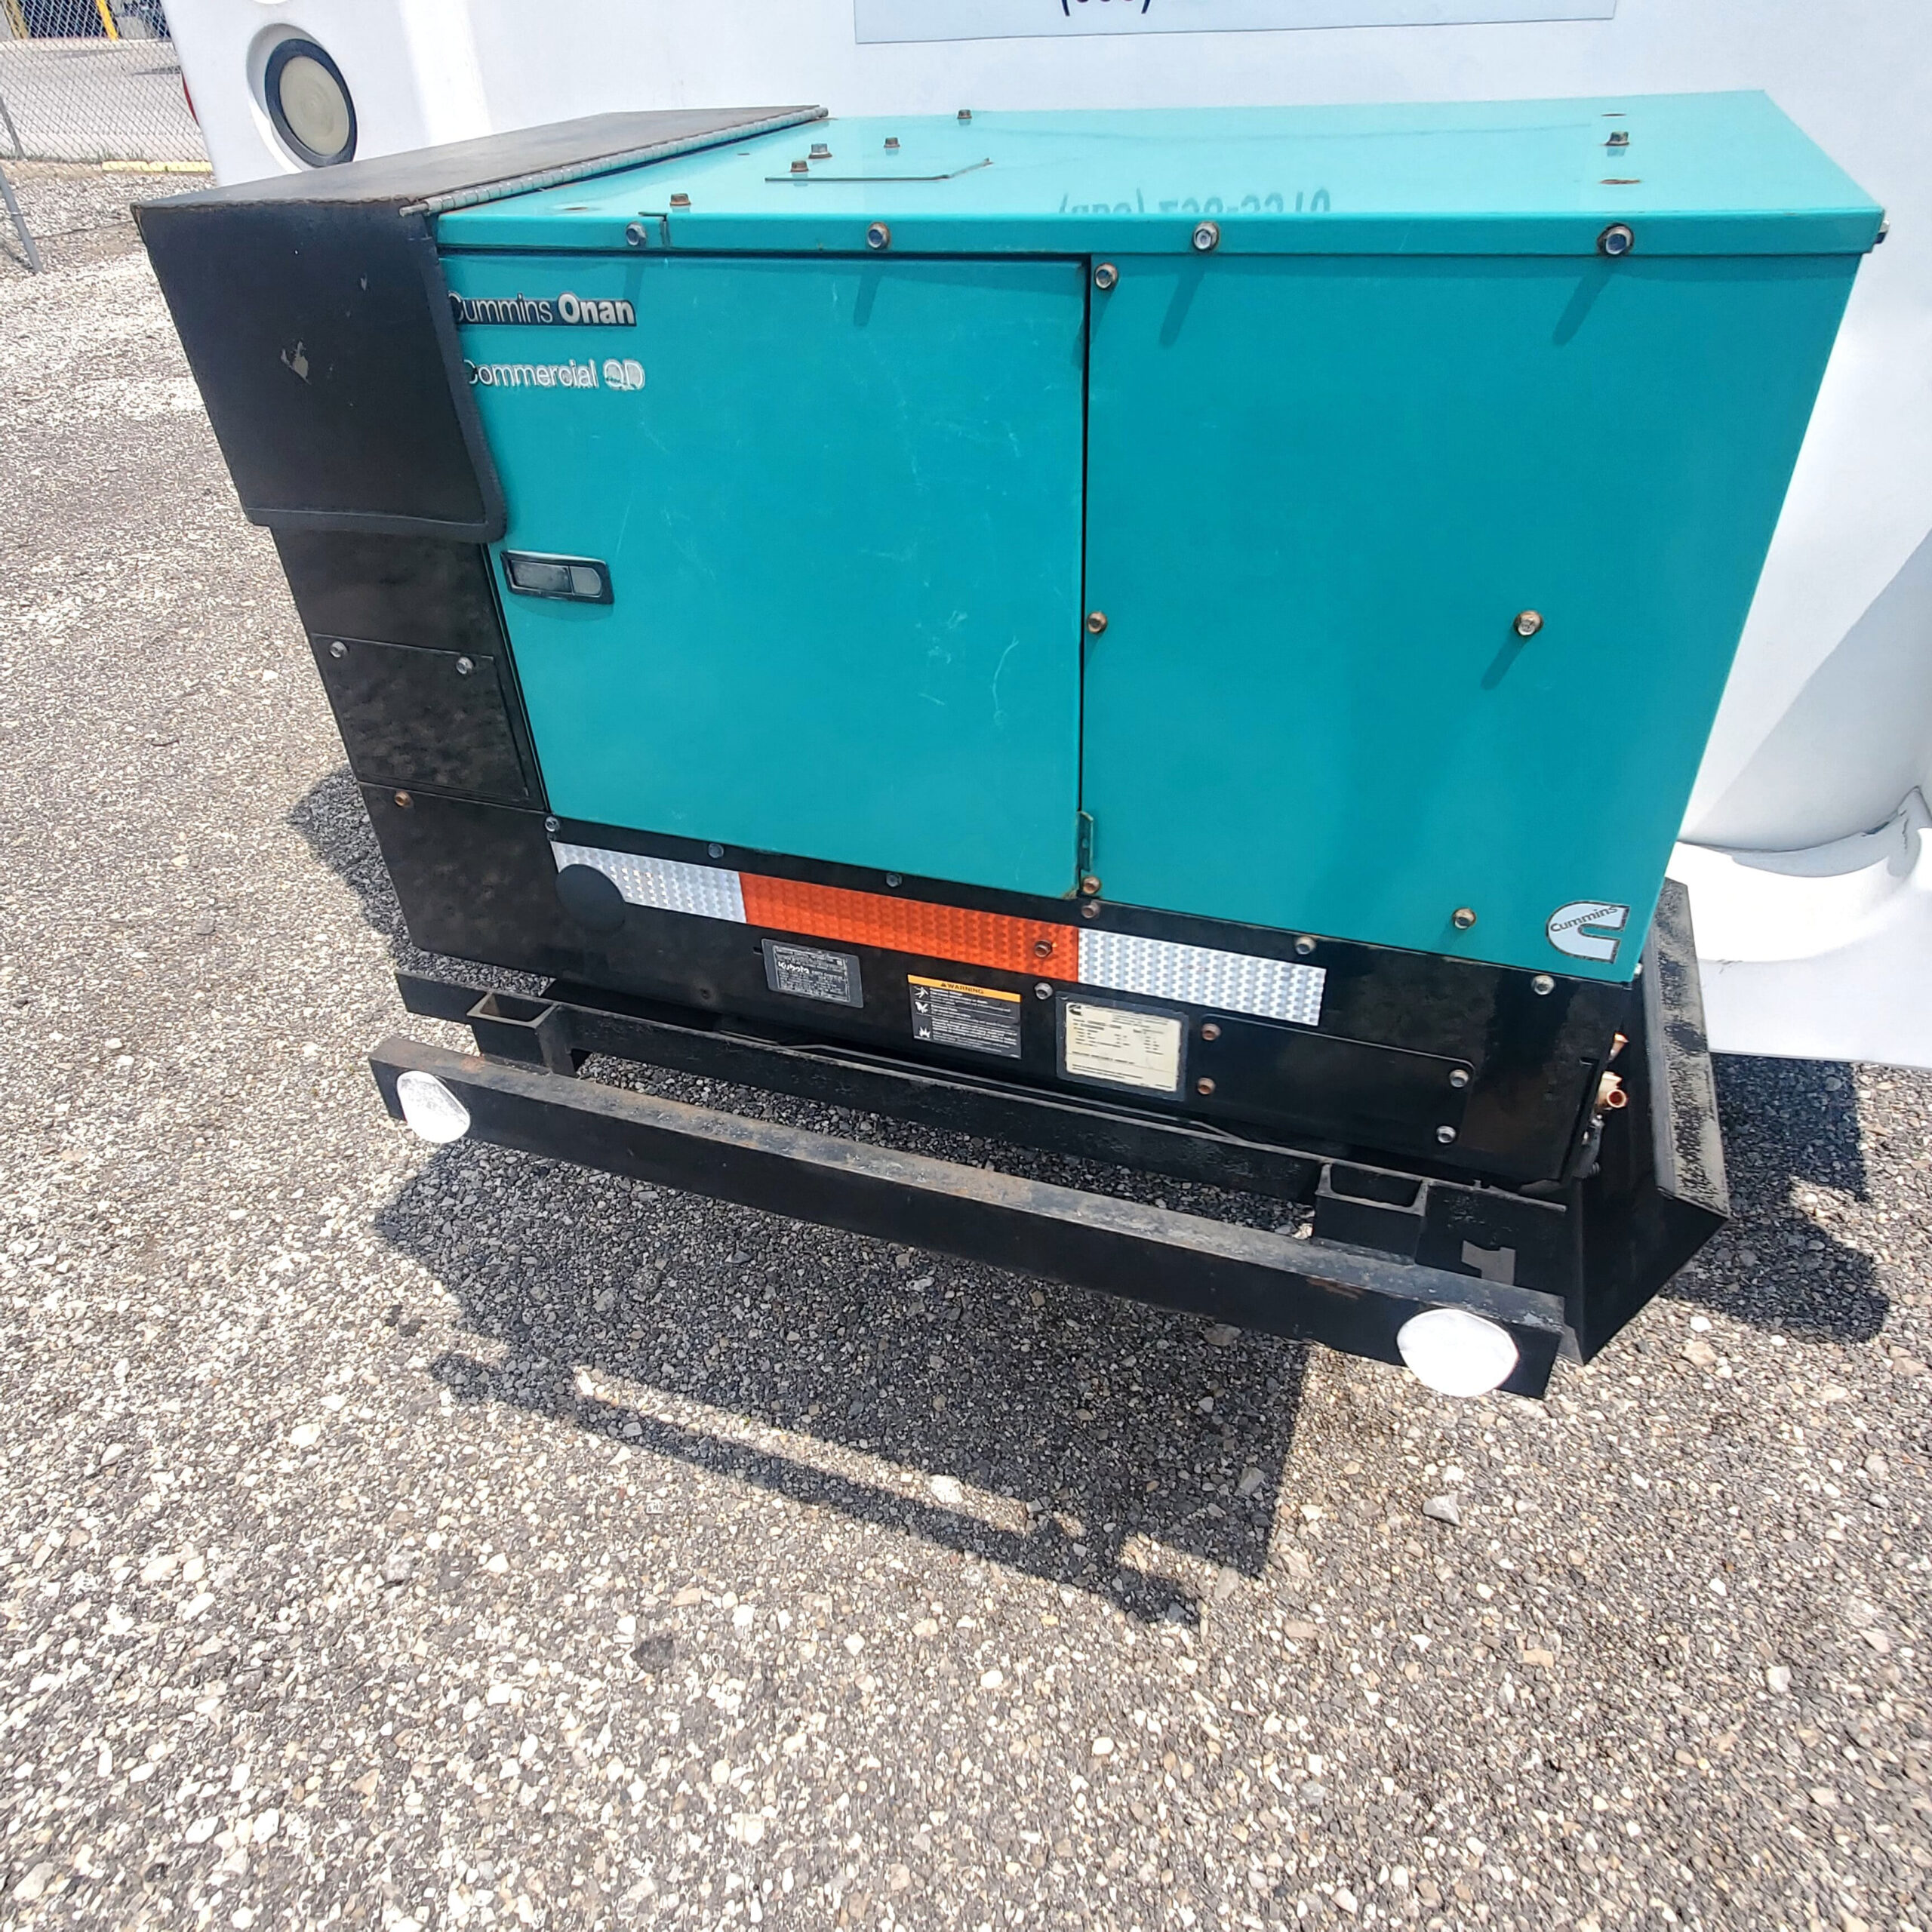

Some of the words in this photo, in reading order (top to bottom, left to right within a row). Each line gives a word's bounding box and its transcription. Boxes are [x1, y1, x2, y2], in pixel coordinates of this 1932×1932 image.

[558, 292, 635, 325] Onan
[1550, 906, 1617, 932] Cummins
[777, 961, 810, 974] Kubota
[948, 983, 984, 995] WARNING
